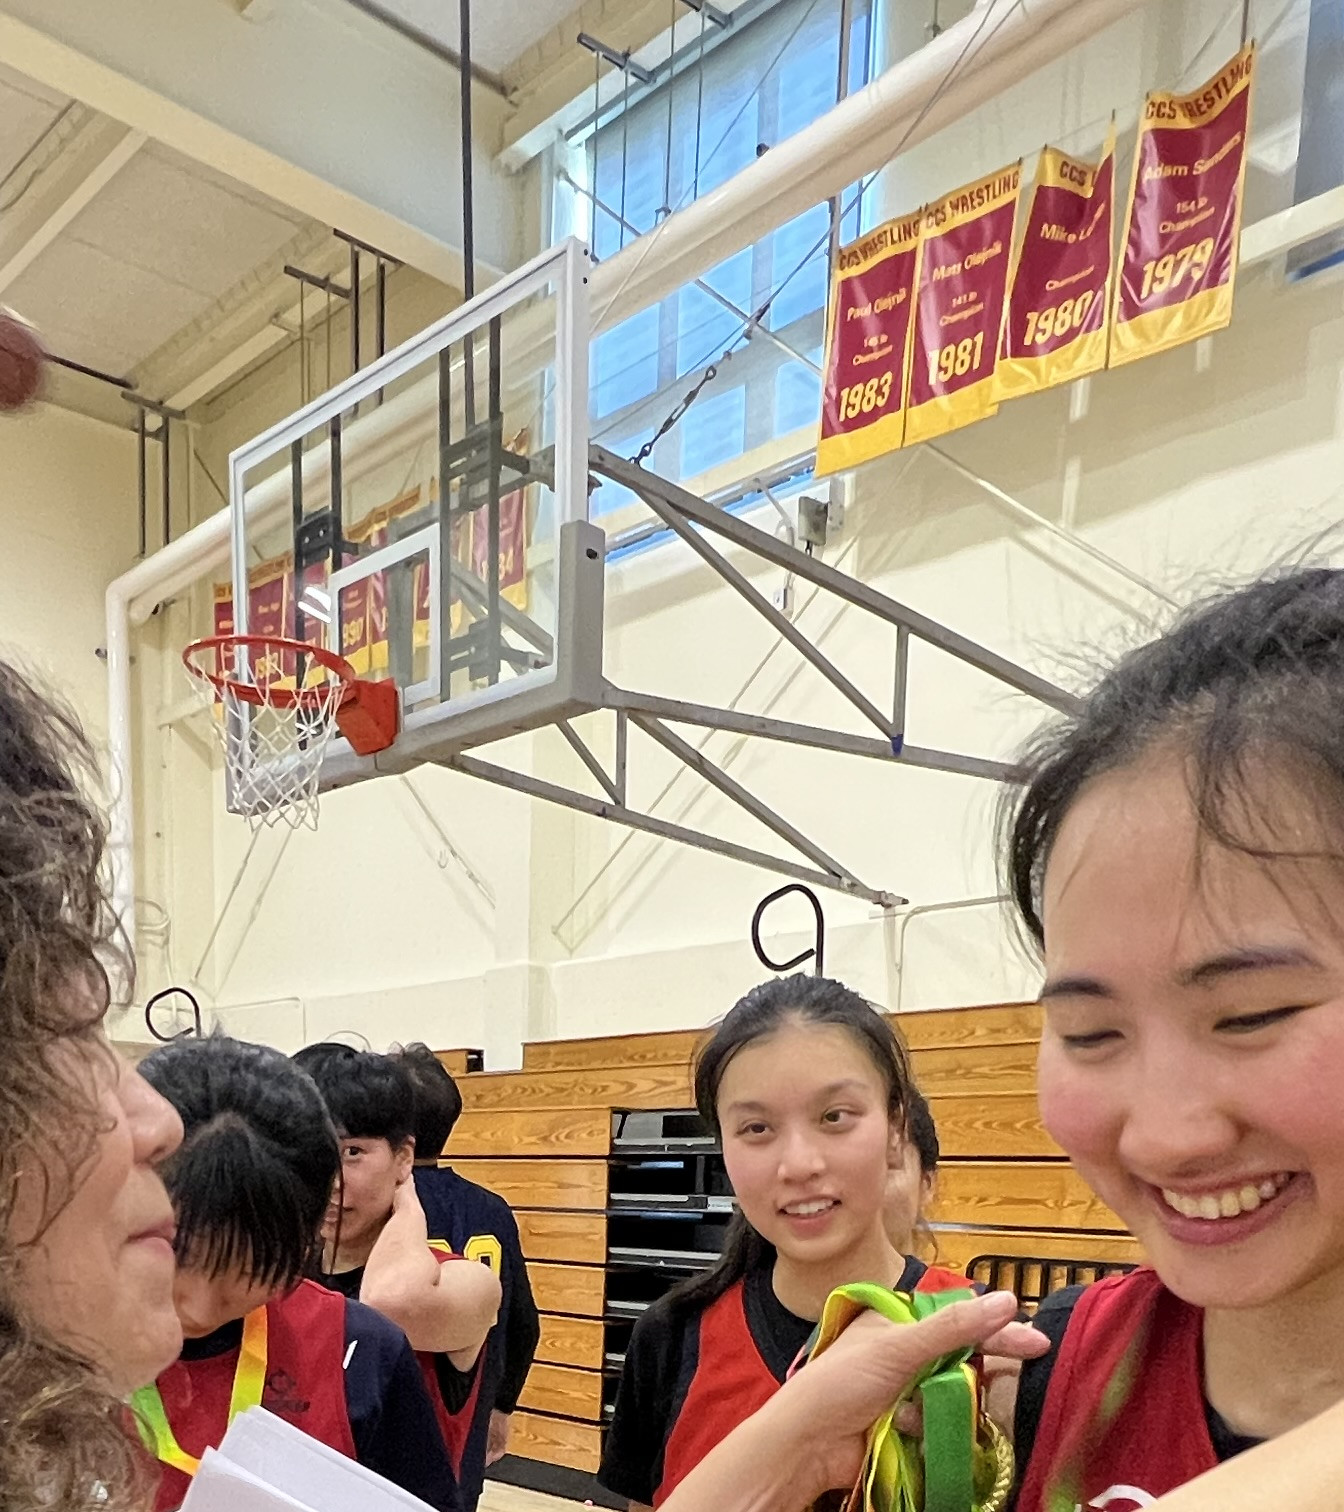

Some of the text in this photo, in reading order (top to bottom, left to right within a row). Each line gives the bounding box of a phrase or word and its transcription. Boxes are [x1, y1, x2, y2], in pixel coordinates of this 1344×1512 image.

[1146, 100, 1177, 120] CCS
[948, 170, 1020, 219] WRESTLING
[1059, 160, 1088, 188] CCS
[1140, 237, 1215, 300] 1979
[1023, 289, 1095, 346] 1980
[927, 331, 985, 387] 1981
[838, 371, 894, 423] 1983
